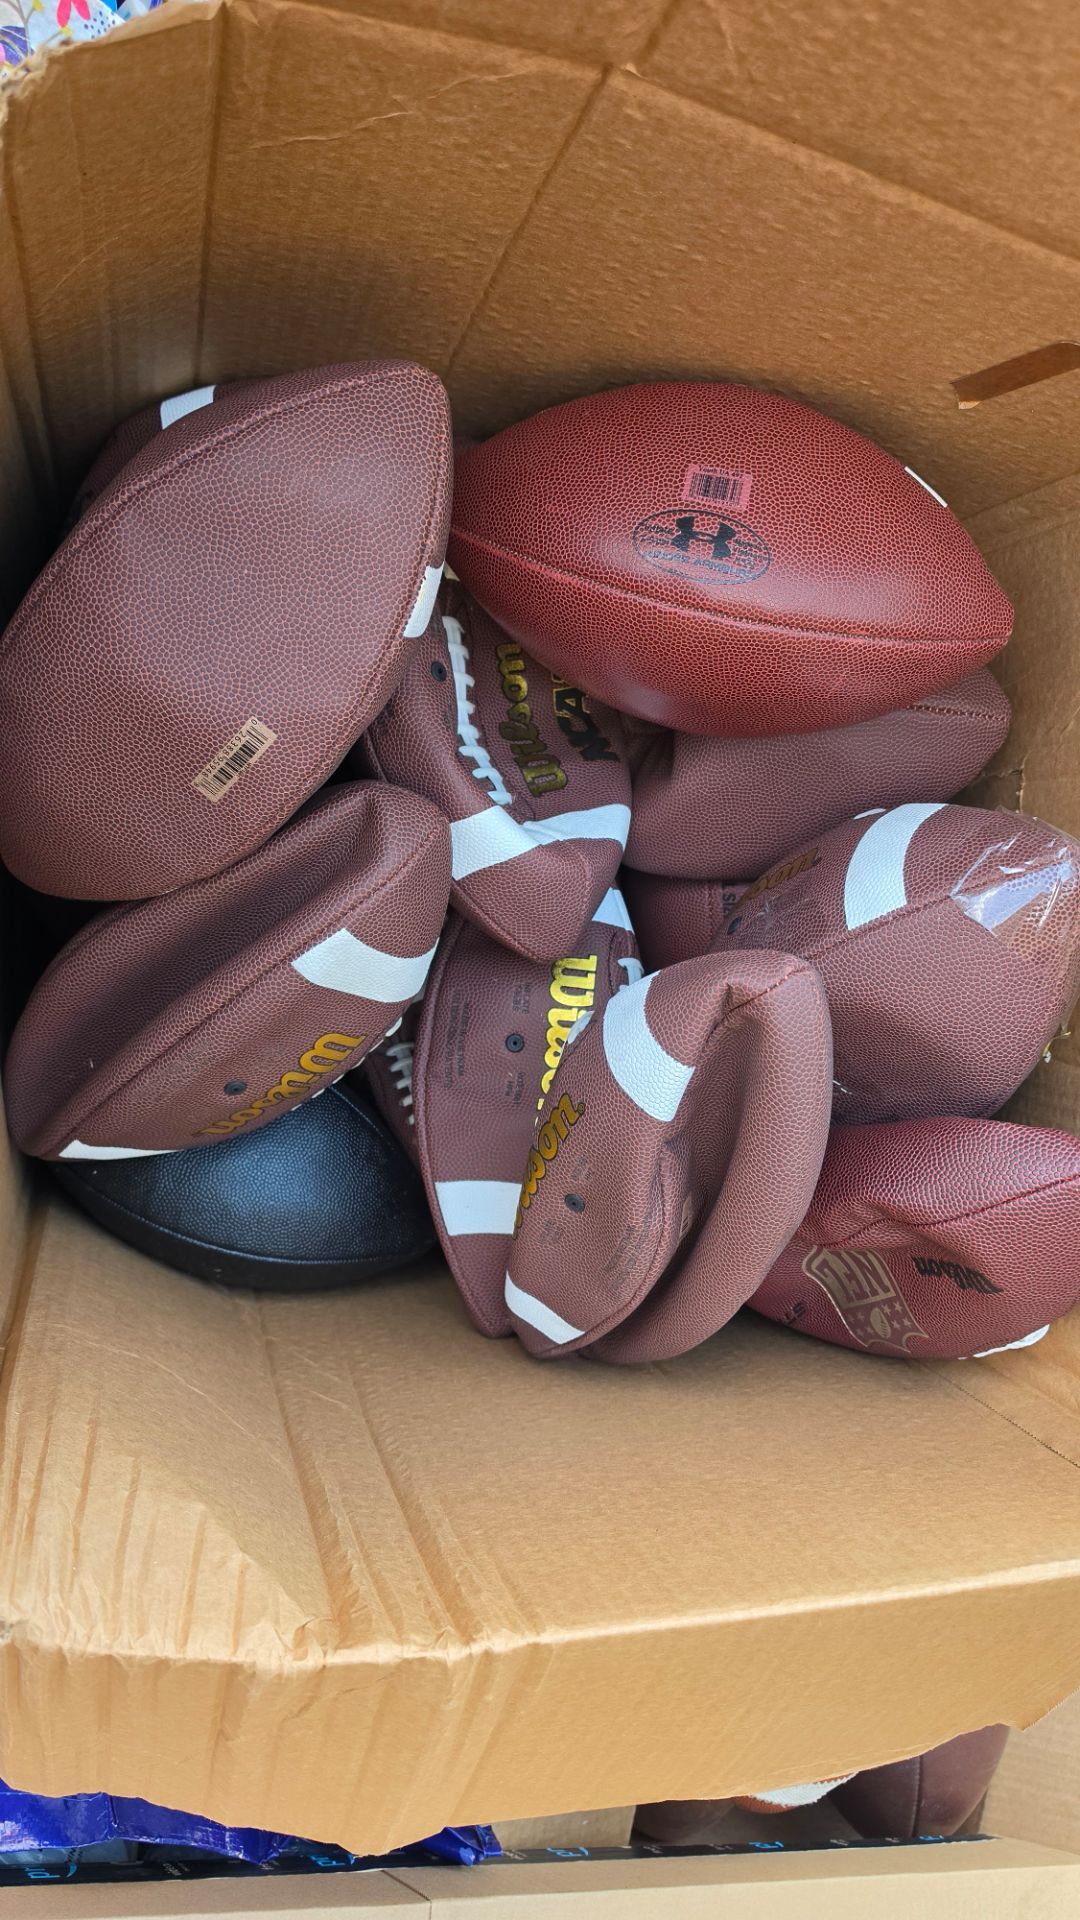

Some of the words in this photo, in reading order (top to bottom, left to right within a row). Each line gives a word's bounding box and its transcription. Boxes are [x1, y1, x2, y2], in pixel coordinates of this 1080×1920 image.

[495, 643, 568, 797] Wilson
[192, 1032, 366, 1137] Wilson
[811, 1249, 895, 1308] NFL
[911, 1256, 1004, 1295] Wilson
